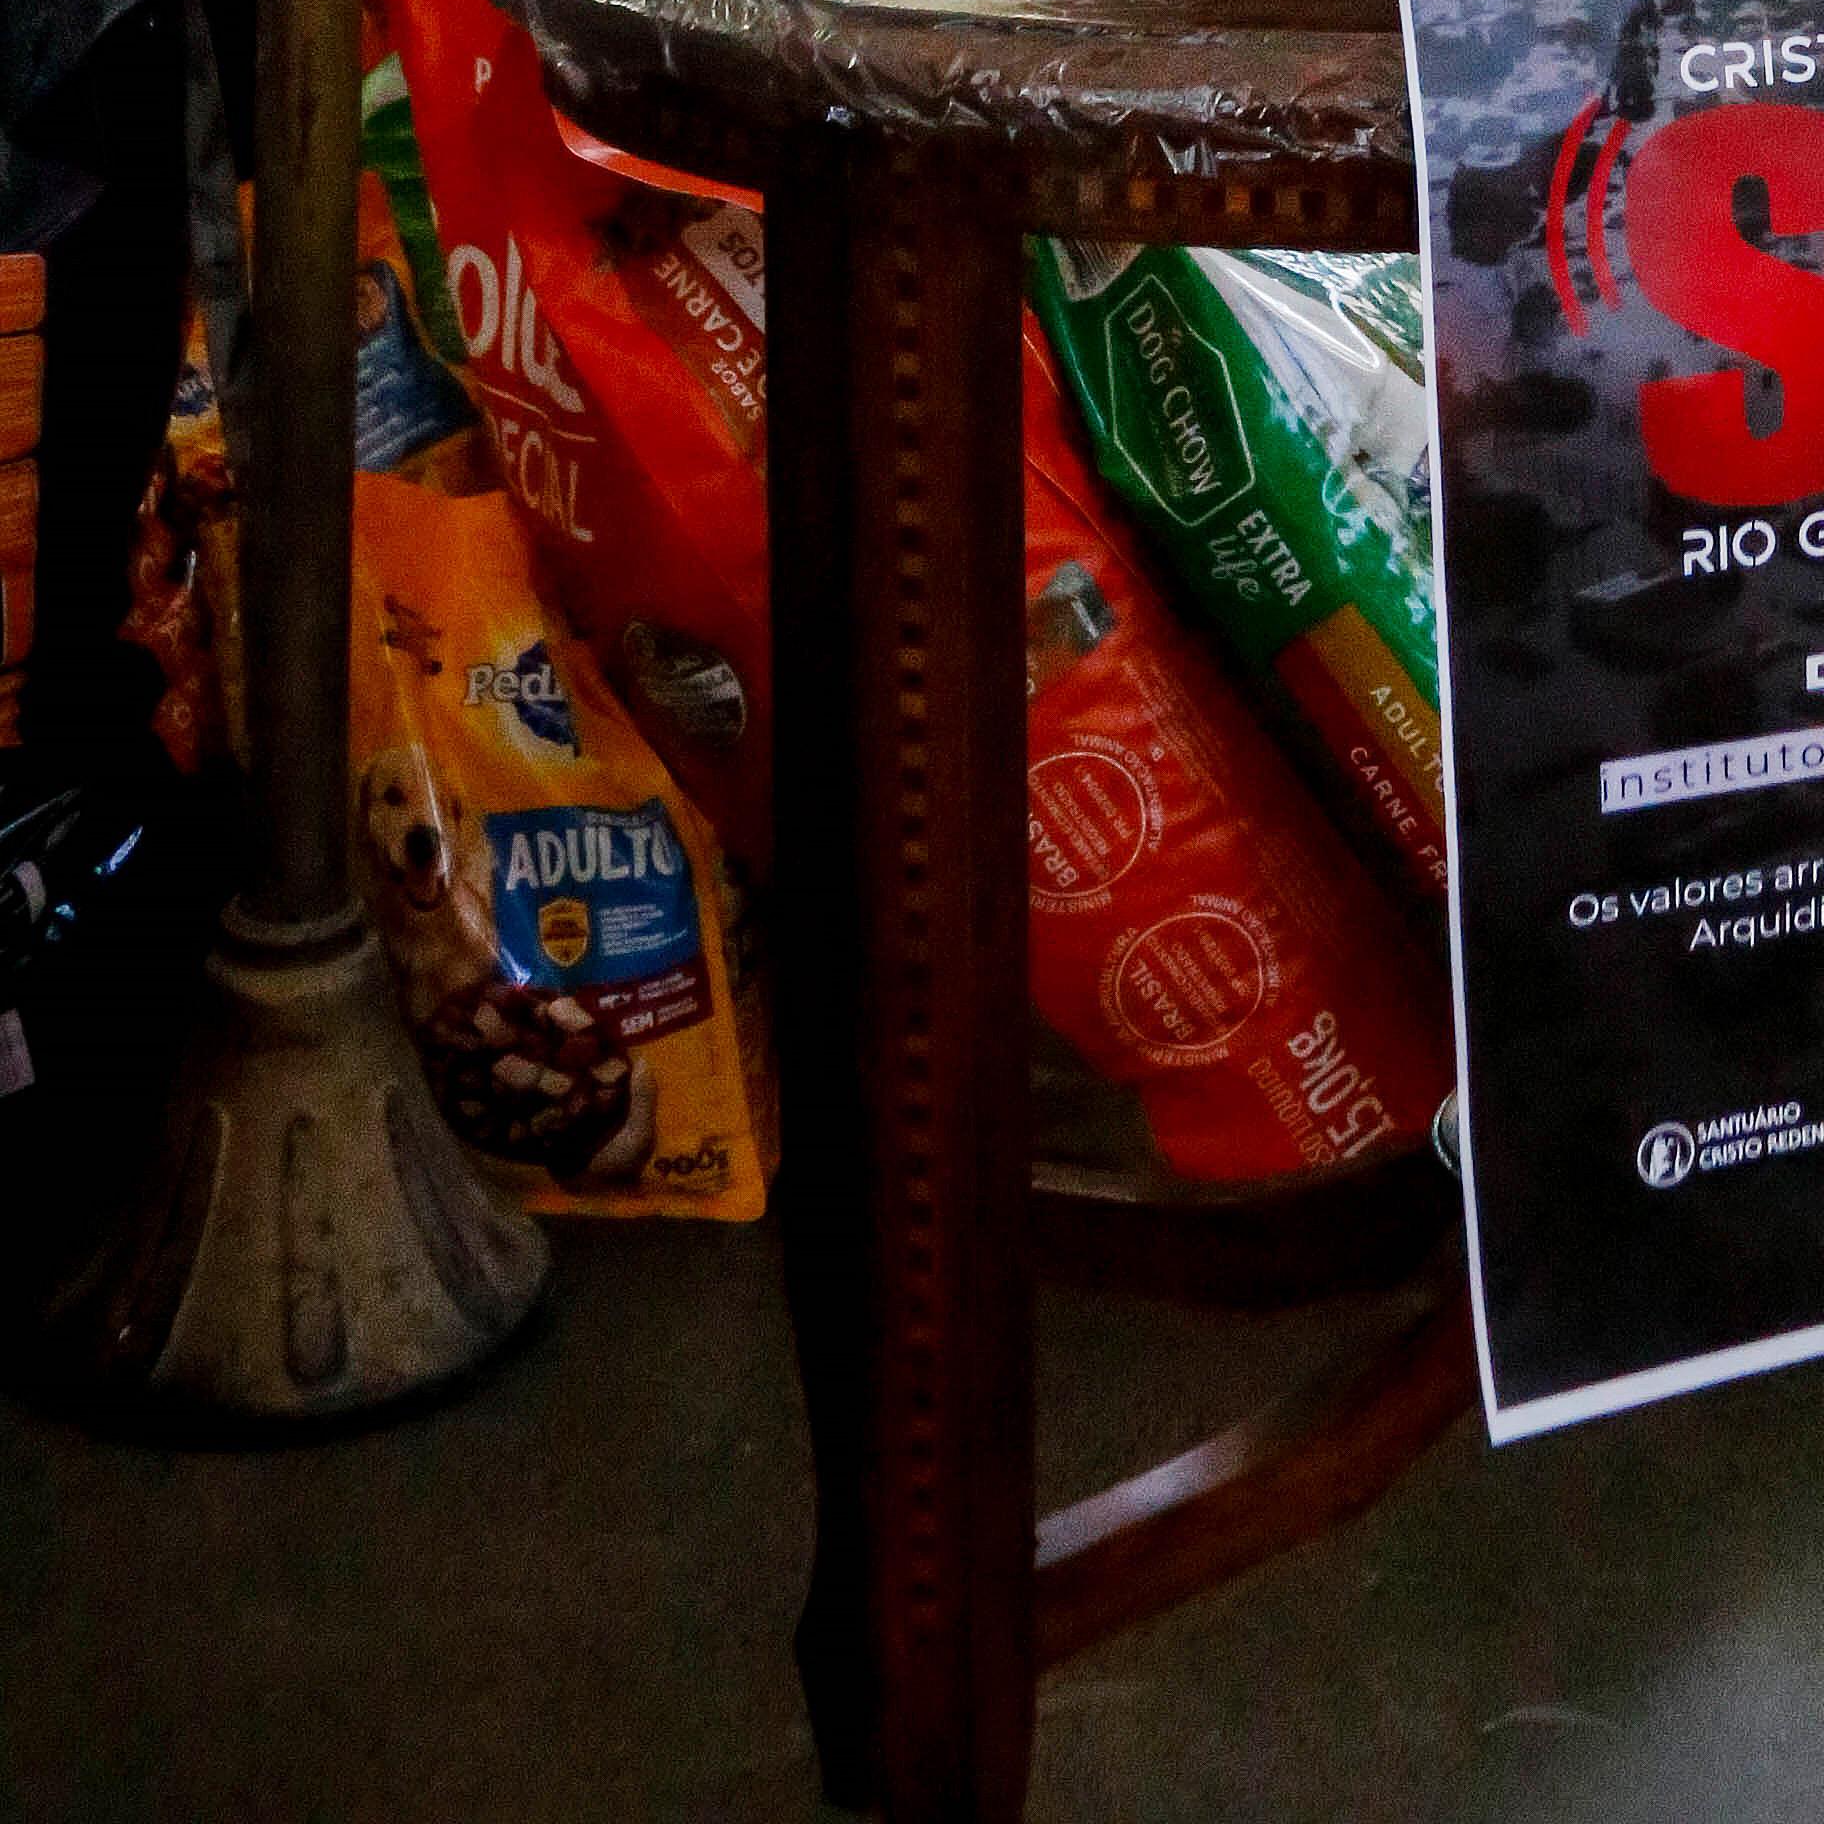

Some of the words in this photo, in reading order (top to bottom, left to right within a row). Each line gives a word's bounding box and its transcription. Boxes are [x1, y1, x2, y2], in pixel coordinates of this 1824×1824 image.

[653, 252, 744, 352] CARNE
[711, 357, 762, 421] SABOR
[1127, 301, 1174, 385] DOG
[1163, 385, 1223, 495] CHOW
[1237, 509, 1313, 606] EXTRA
[1683, 518, 1777, 577] RIO
[1351, 746, 1417, 835] CARNE
[505, 821, 676, 891] ADULTO
[1028, 812, 1078, 888] BRAS
[1569, 892, 1618, 928] Os
[1630, 866, 1762, 917] valores
[1287, 1010, 1396, 1160] 15,0kg
[1697, 1102, 1801, 1145] SANTUÁRIO
[1699, 1135, 1762, 1171] CRISTO
